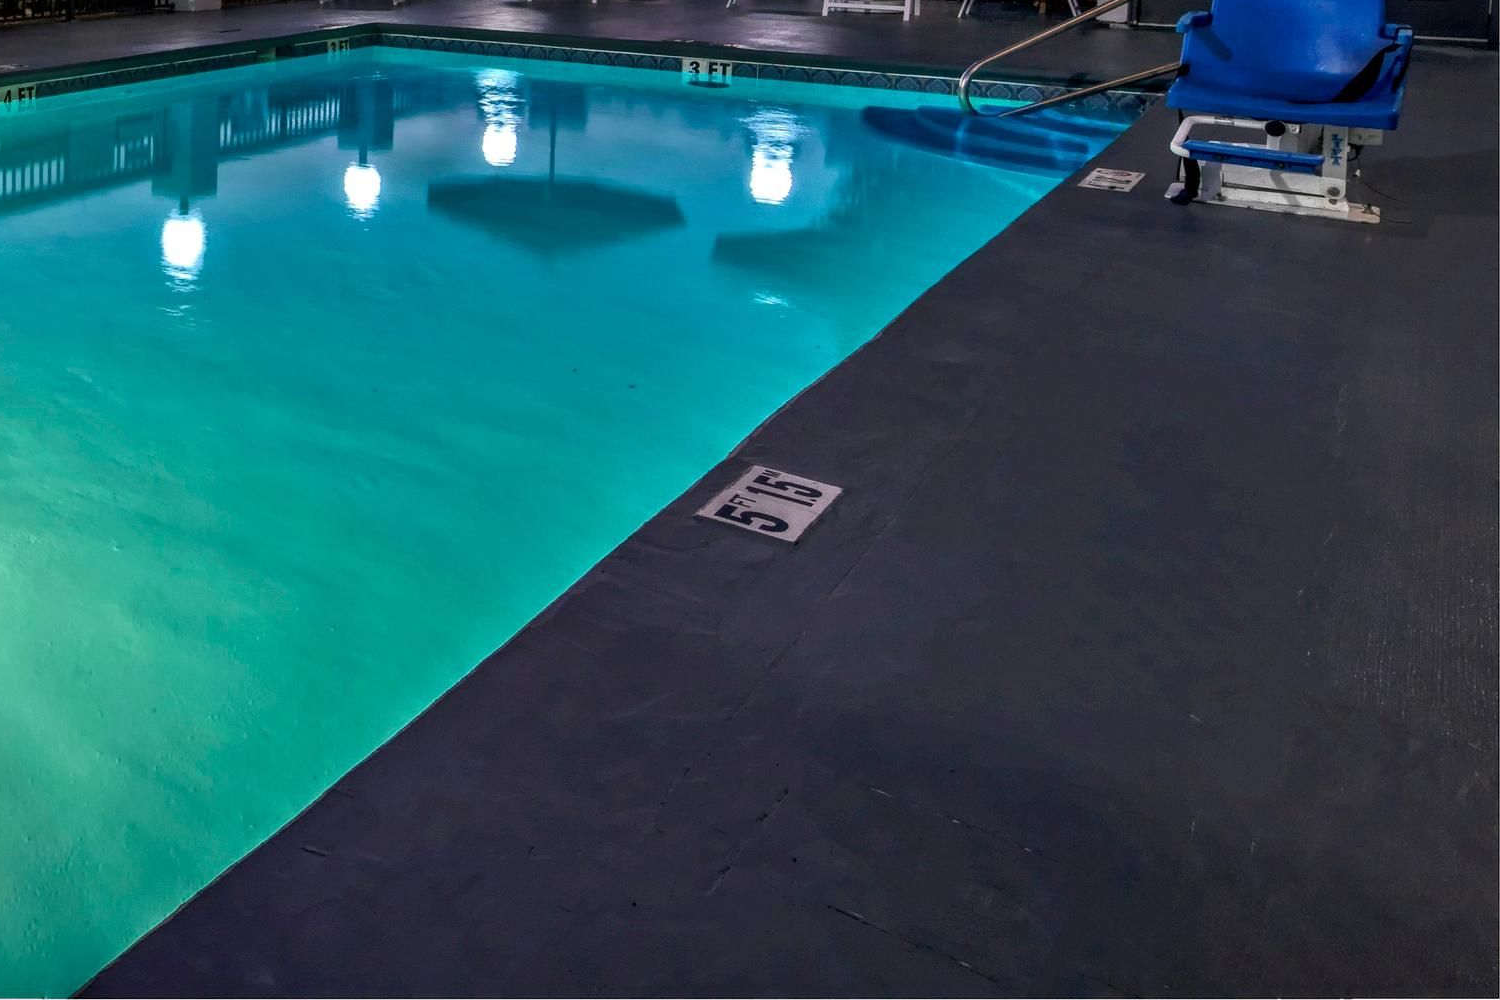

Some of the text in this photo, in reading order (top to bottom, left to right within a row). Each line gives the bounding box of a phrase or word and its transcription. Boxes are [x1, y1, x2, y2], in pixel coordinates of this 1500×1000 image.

[689, 61, 730, 76] 3 FT
[18, 86, 34, 102] FT
[729, 494, 757, 508] FT
[713, 503, 790, 533] 5
